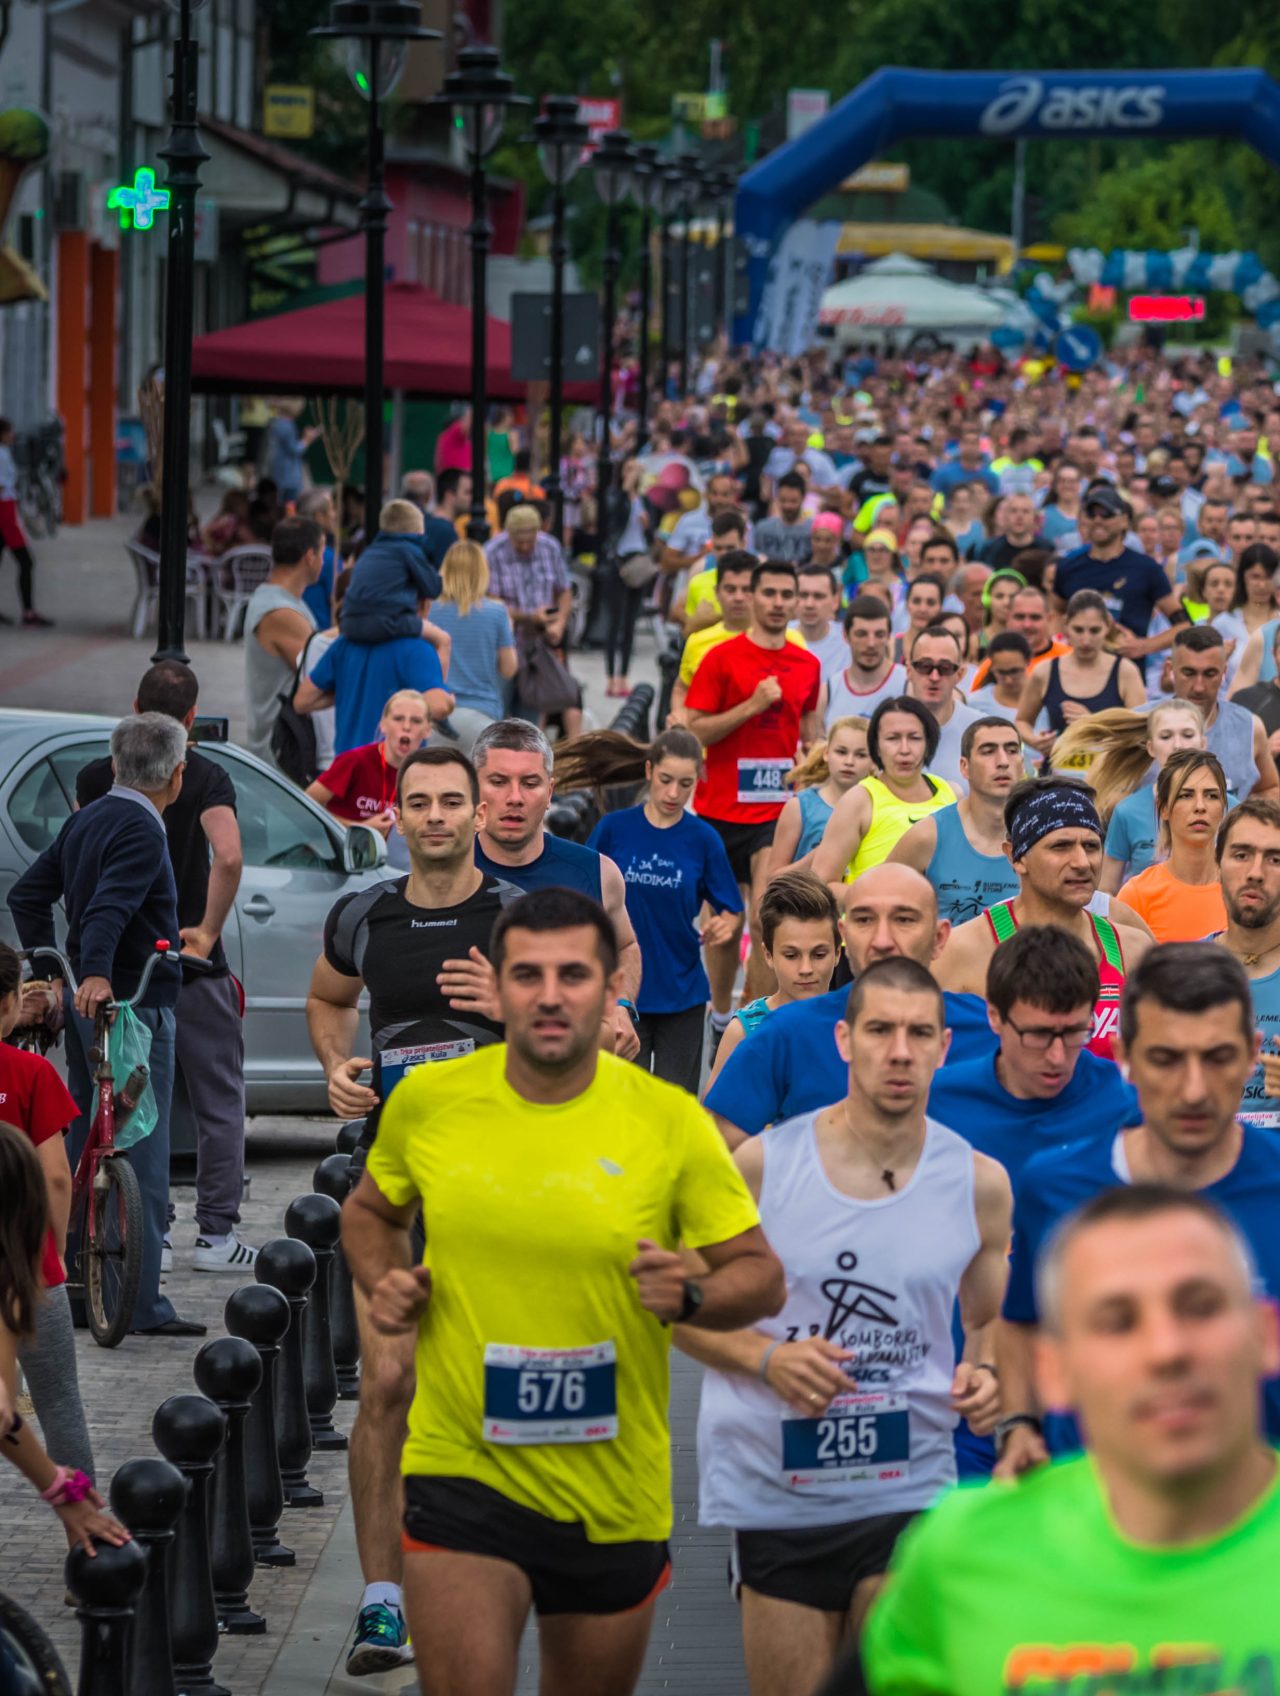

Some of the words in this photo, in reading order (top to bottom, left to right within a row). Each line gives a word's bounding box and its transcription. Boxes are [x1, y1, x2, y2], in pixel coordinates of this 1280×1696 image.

[1040, 85, 1165, 128] asics
[753, 769, 781, 788] 448
[411, 919, 457, 929] hummel
[430, 1051, 447, 1059] Kula
[517, 1370, 586, 1413] 576
[816, 1416, 878, 1460] 255
